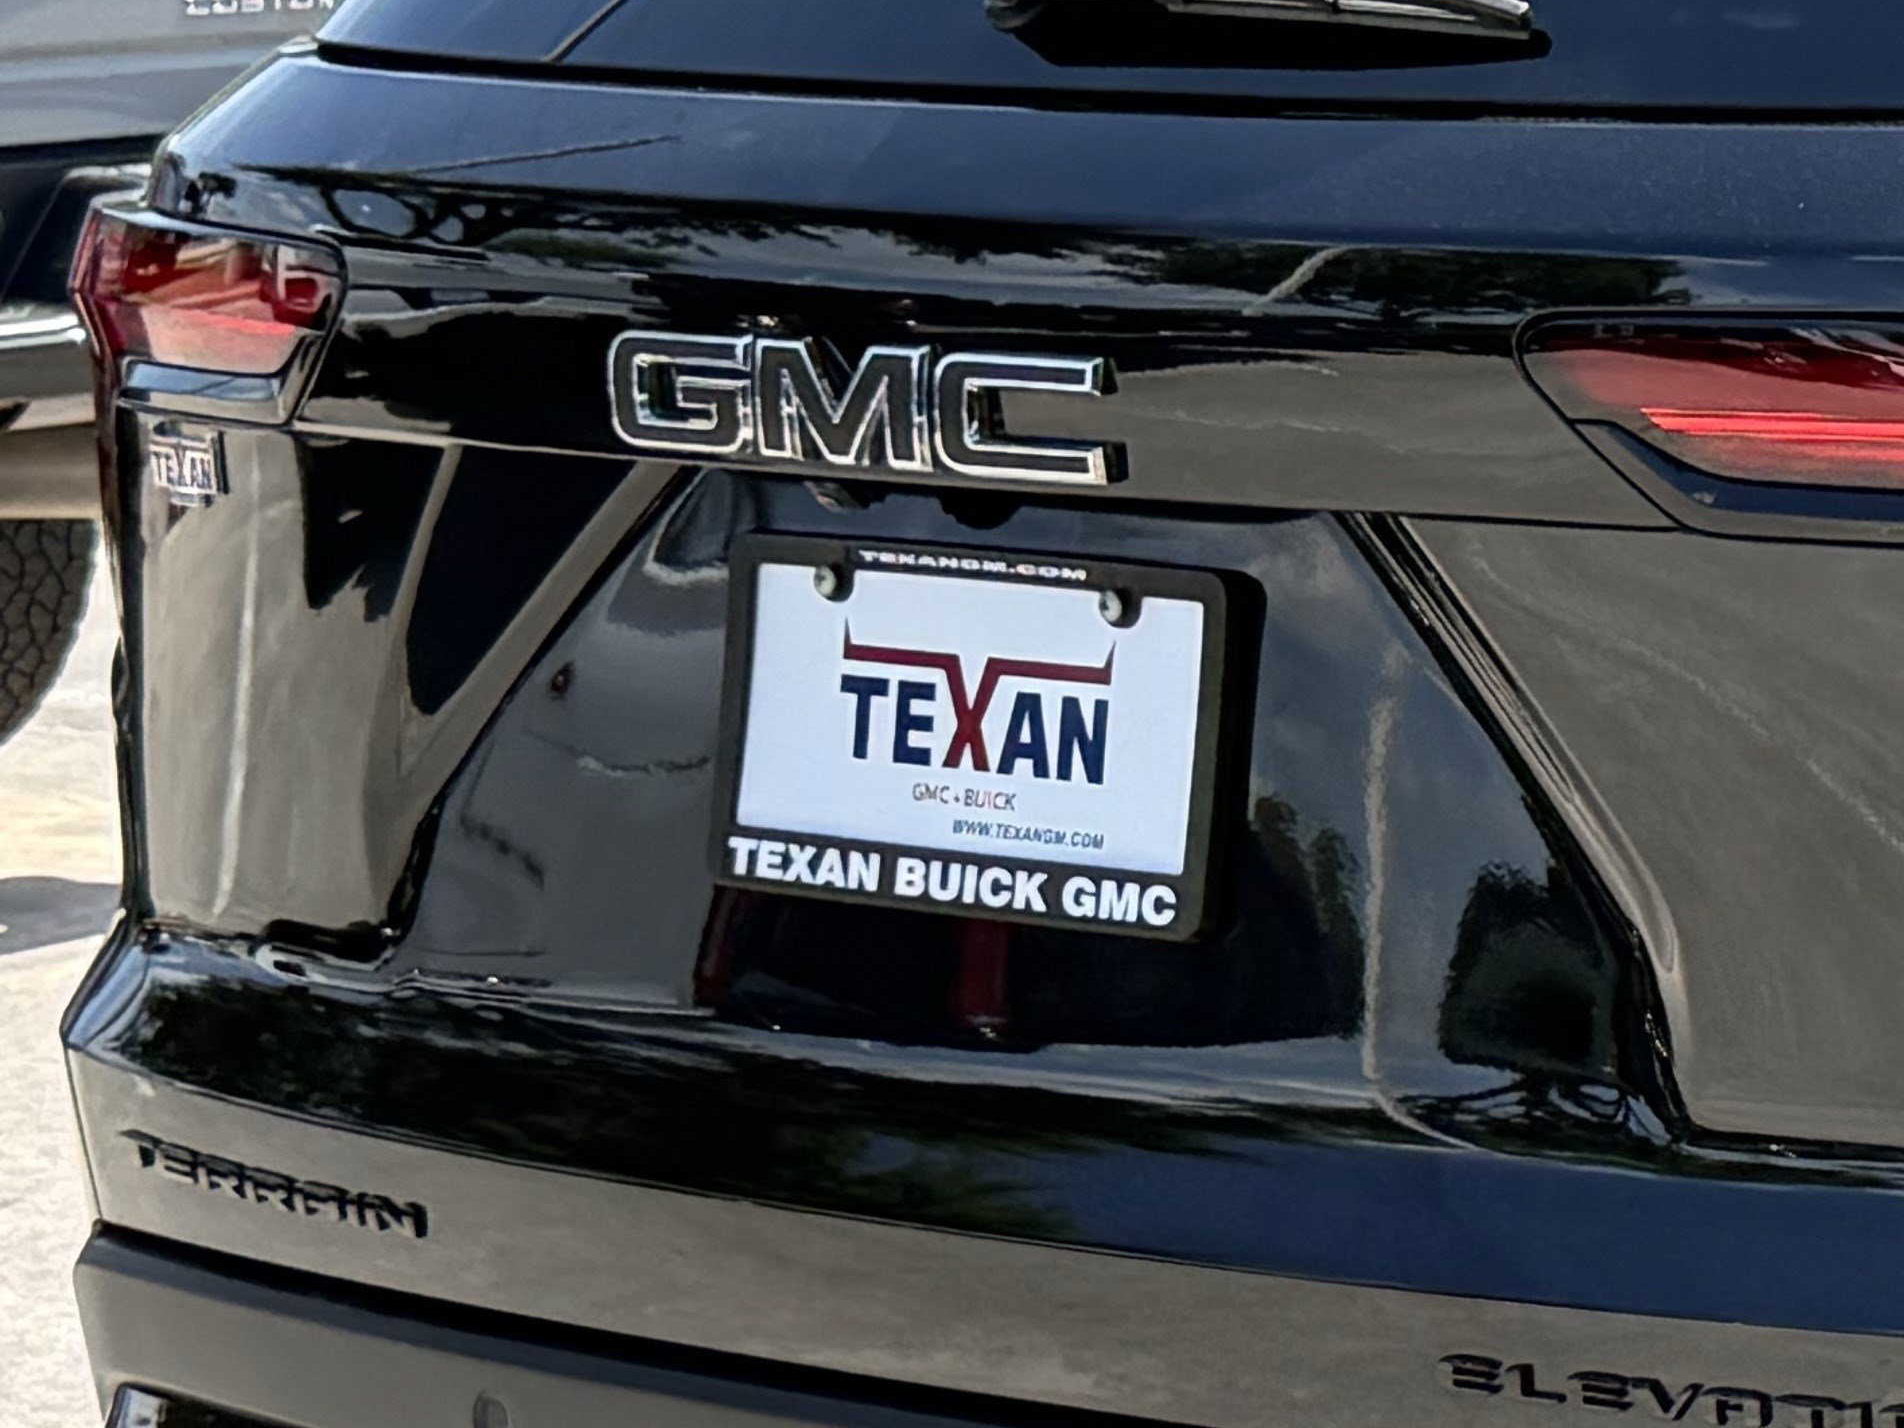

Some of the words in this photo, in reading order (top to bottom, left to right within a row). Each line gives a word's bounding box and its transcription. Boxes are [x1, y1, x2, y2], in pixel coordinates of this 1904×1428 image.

[606, 329, 1129, 487] GMC
[150, 440, 213, 490] TEXAN
[840, 630, 1115, 785] TEXAN
[727, 835, 882, 893] TEXAN
[893, 856, 1049, 913] BUICK
[1061, 874, 1178, 927] GMC
[952, 818, 1105, 850] WWW.TEXANGM.COM
[118, 1127, 429, 1240] TERRAIN
